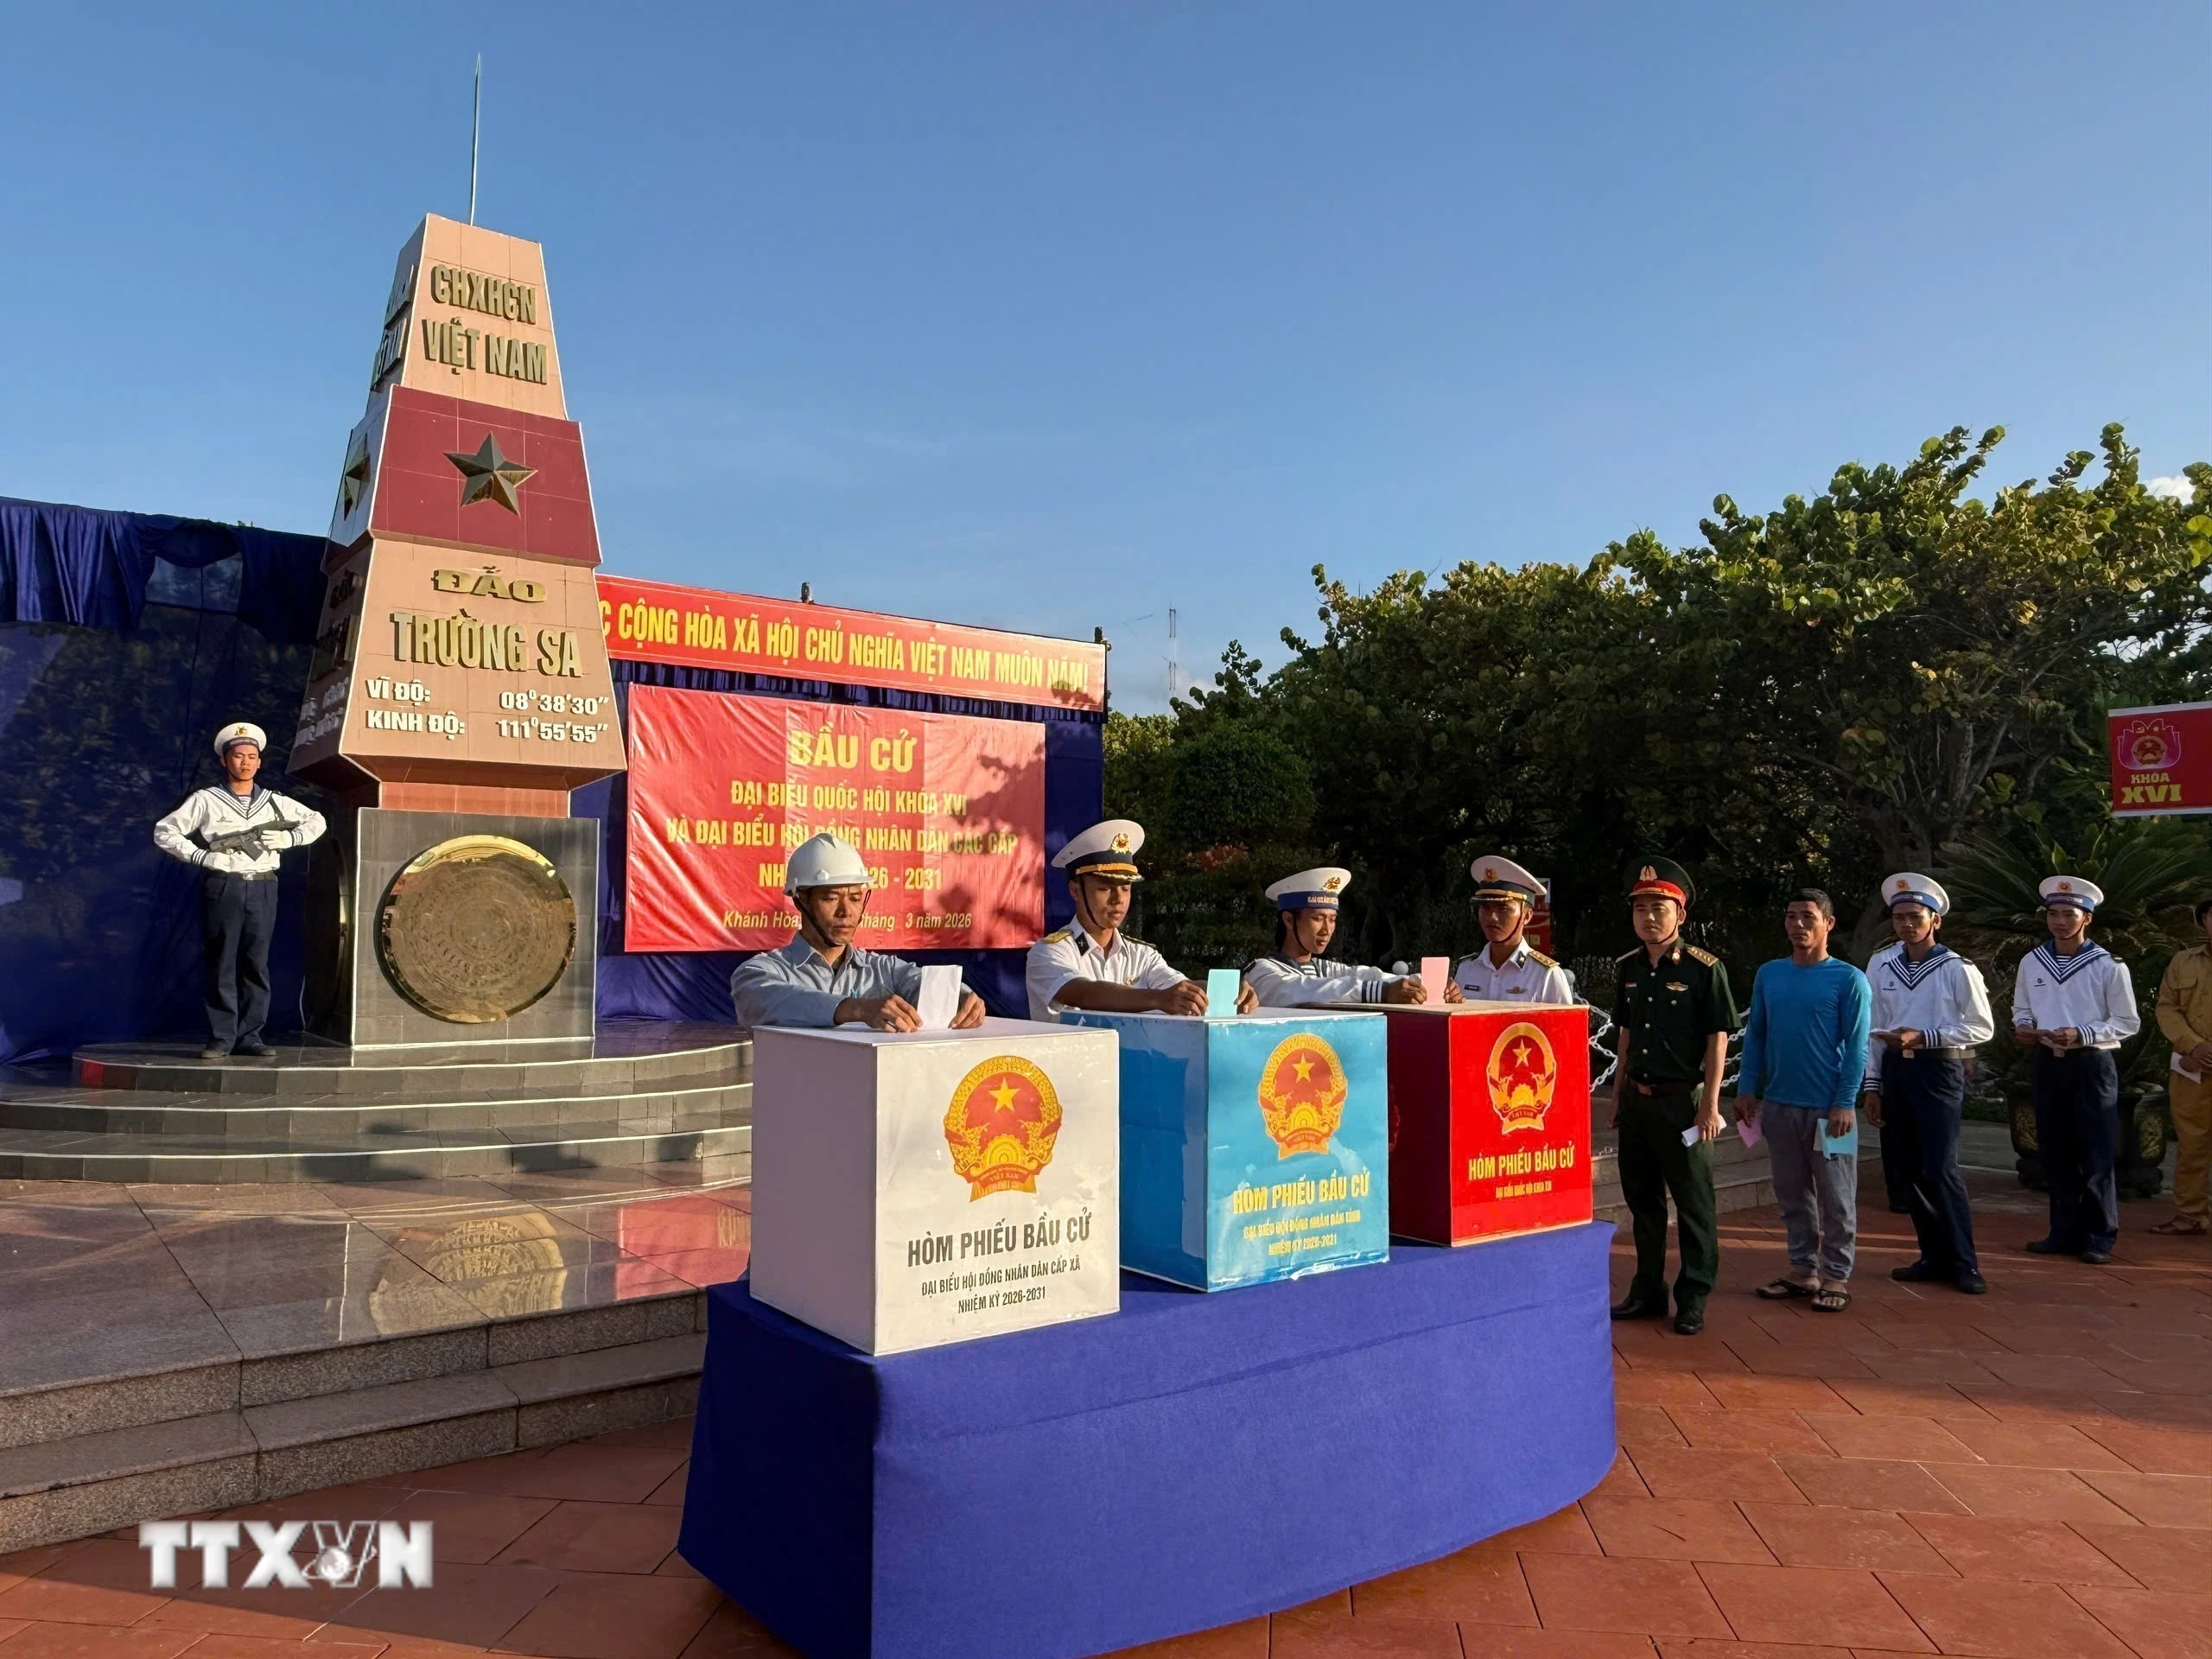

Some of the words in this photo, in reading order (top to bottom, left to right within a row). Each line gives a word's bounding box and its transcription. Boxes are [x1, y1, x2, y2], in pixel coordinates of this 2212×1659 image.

[431, 264, 536, 325] CHXHCN
[422, 317, 480, 375] VIỆT
[485, 333, 547, 385] NAM
[390, 608, 529, 671] TRƯỜNG
[537, 628, 582, 677] SA
[618, 597, 678, 648] CỘNG
[685, 604, 727, 651] HÒA
[733, 613, 760, 655] XÃ
[766, 616, 799, 665] HỘI
[805, 620, 844, 664] CHỦ
[849, 632, 905, 671] NGHĨA
[910, 637, 946, 682] VIỆT
[950, 645, 990, 681] NAM
[995, 649, 1043, 687] MUÔN
[365, 675, 391, 700] VĨ
[393, 678, 431, 707] ĐỘ:
[365, 709, 423, 733] KINH
[428, 711, 466, 741] ĐỘ:
[789, 721, 859, 770] BẦU
[870, 728, 918, 773] CỬ
[731, 779, 762, 810] ĐẠI
[768, 774, 808, 808] BIỂU
[813, 779, 858, 811] QUỐC
[864, 785, 891, 817] HỘI
[895, 787, 938, 816] KHÓA
[943, 792, 967, 817] XVI
[2121, 784, 2182, 804] XVI
[665, 815, 690, 845] VÀ
[695, 819, 728, 849] ĐẠI
[733, 813, 775, 847] BIỂU
[866, 823, 912, 852] NHÂN
[917, 825, 949, 853] DÂN
[953, 827, 983, 855] CÁC
[988, 825, 1018, 855] CẤP
[905, 868, 942, 891] 2031
[722, 910, 769, 929] Khánh
[860, 912, 895, 932] tháng
[905, 912, 913, 929] 3
[916, 912, 942, 928] năm
[944, 912, 972, 929] 2026
[1468, 1151, 1496, 1181] HÒM
[1498, 1146, 1532, 1177] PHIẾU
[1535, 1143, 1557, 1172] BẦU
[1560, 1141, 1575, 1169] CỬ
[1272, 1174, 1315, 1209] PHIẾU
[1319, 1169, 1347, 1203] BẦU
[1351, 1166, 1370, 1198] CỬ
[907, 1230, 954, 1268] HÒM
[960, 1217, 1017, 1260] PHIẾU
[1023, 1211, 1061, 1249] BẦU
[1066, 1206, 1092, 1243] CỬ
[921, 1280, 937, 1299] ĐẠI
[939, 1271, 960, 1294] BIỂU
[962, 1271, 976, 1292] HỘI
[979, 1266, 1002, 1287] ĐỒNG
[1005, 1263, 1029, 1281] NHÂN
[1032, 1260, 1049, 1278] DÂN
[1051, 1255, 1067, 1274] CẤP
[1070, 1255, 1080, 1271] XÃ
[958, 1294, 987, 1314] NHIỆM
[989, 1289, 1001, 1308] KỲ
[1002, 1286, 1046, 1306] 2026-2031
